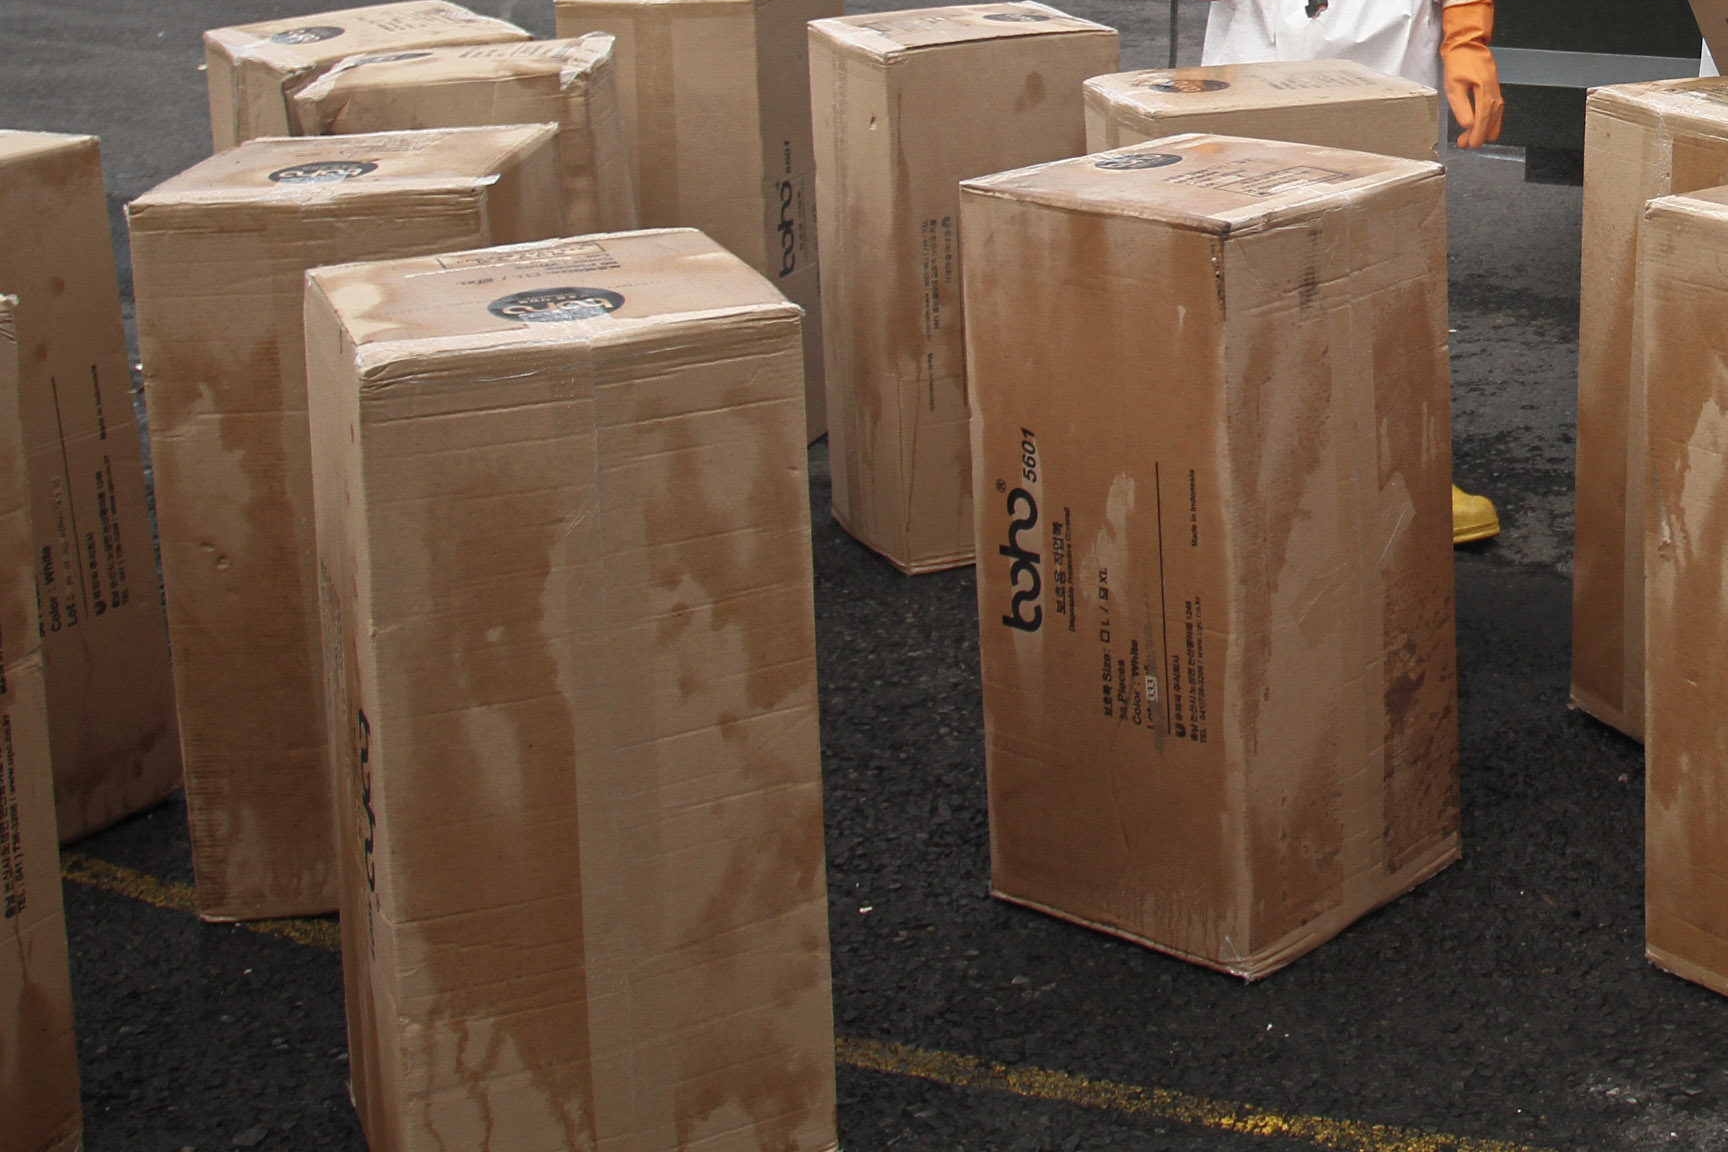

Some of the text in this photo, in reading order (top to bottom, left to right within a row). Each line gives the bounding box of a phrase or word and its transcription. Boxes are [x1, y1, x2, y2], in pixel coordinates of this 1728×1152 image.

[999, 427, 1042, 633] boho 5601
[42, 545, 55, 586] White
[1052, 521, 1066, 615] 보호용 작업복
[1099, 568, 1108, 583] XL
[1118, 659, 1126, 702] Pieces
[1130, 640, 1141, 725] Color White
[2, 714, 15, 794] www.upc.co.kr
[18, 890, 26, 913] TEL
